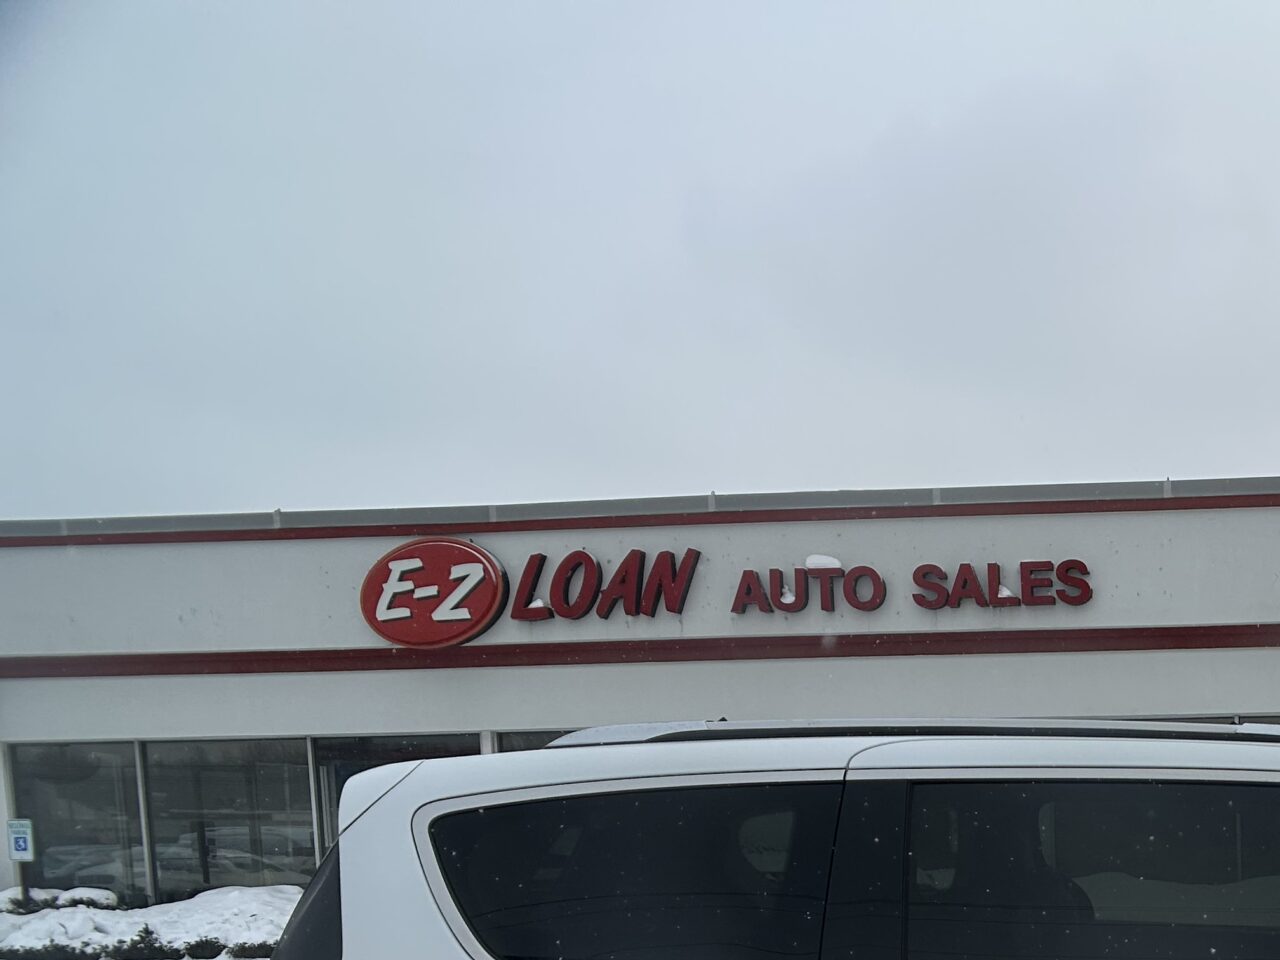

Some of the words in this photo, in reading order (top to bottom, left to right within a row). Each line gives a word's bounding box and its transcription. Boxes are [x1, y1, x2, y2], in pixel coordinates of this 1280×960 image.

[375, 557, 486, 622] E-Z
[511, 547, 701, 622] LOAN
[730, 565, 887, 614] AUTO
[911, 559, 1094, 610] SALES
